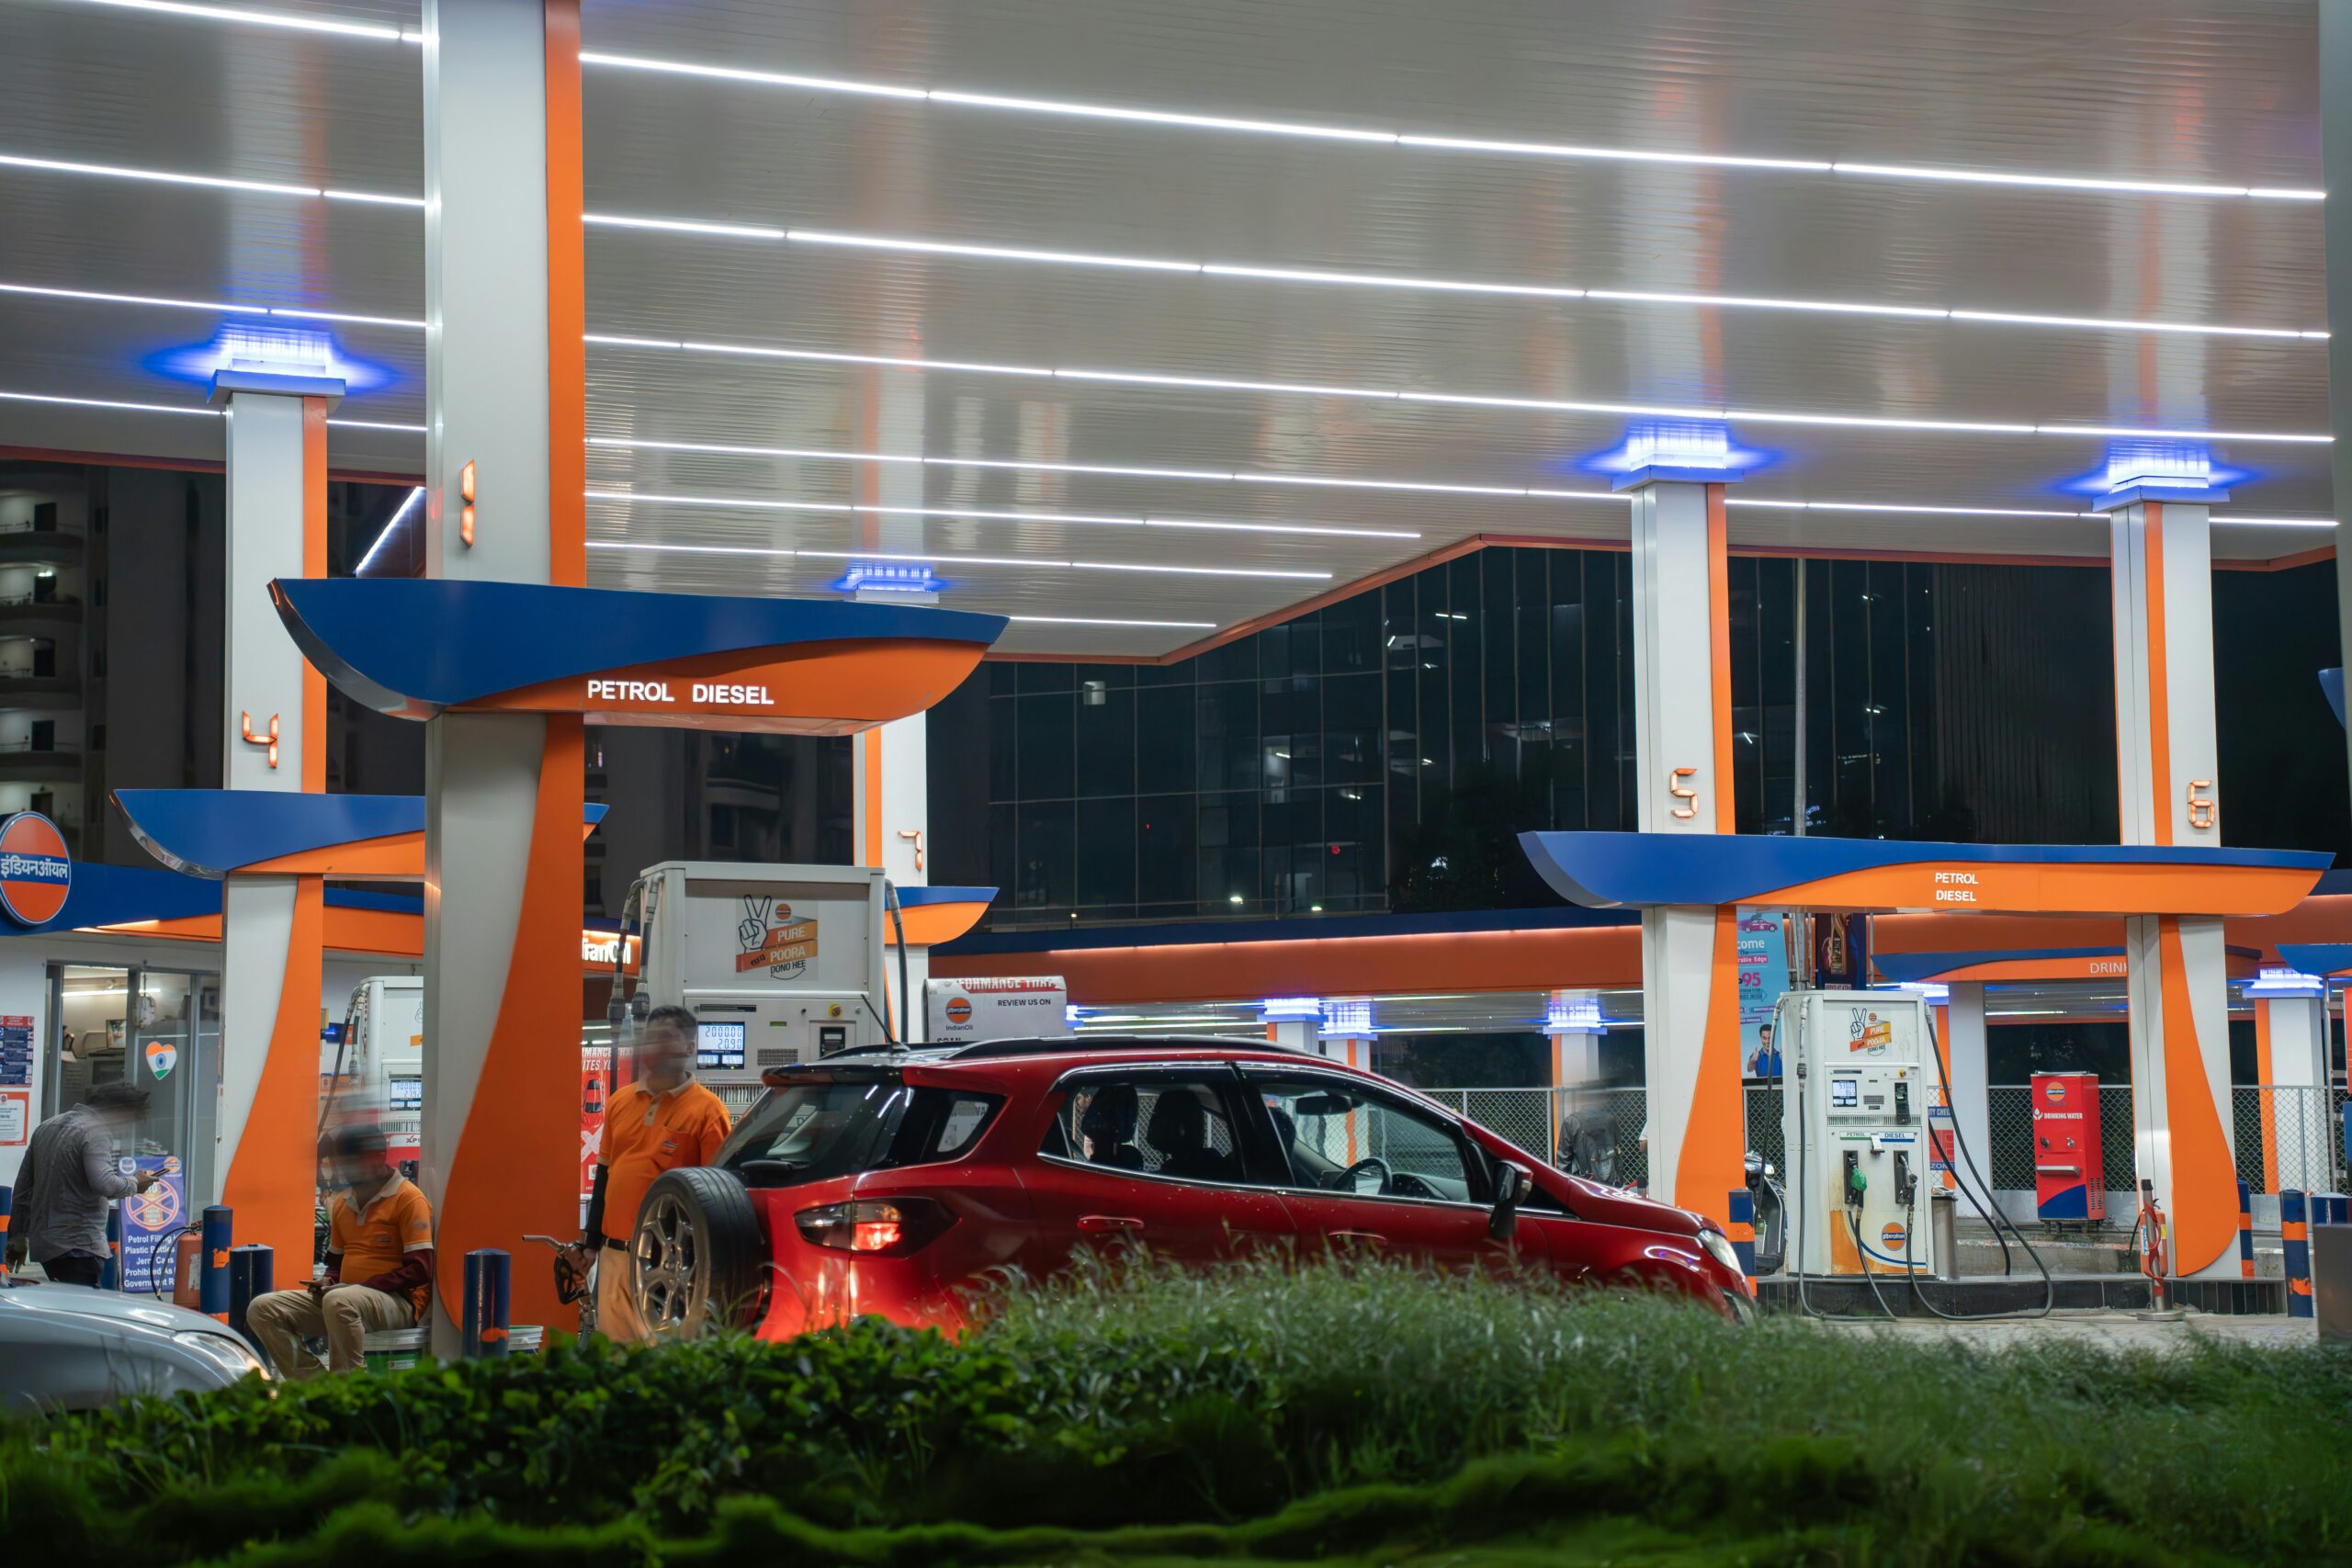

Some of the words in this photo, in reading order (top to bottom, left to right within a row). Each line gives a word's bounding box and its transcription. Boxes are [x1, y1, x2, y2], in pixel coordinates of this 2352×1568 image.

[460, 458, 475, 547] 1
[587, 680, 674, 702] PETROL
[692, 683, 775, 705] DIESEL
[242, 711, 278, 768] 4
[1669, 767, 1698, 818] 5
[2188, 779, 2215, 829] 6
[898, 830, 922, 872] 7
[1935, 872, 1979, 885] PETROL
[1936, 890, 1977, 901] DIESEL
[777, 927, 806, 942] PURE
[770, 946, 806, 962] POORA
[770, 963, 791, 975] DONO
[792, 959, 807, 969] HEE
[128, 1235, 149, 1244] Petrol
[125, 1247, 149, 1255] Plastic
[125, 1269, 162, 1277] Prohibied
